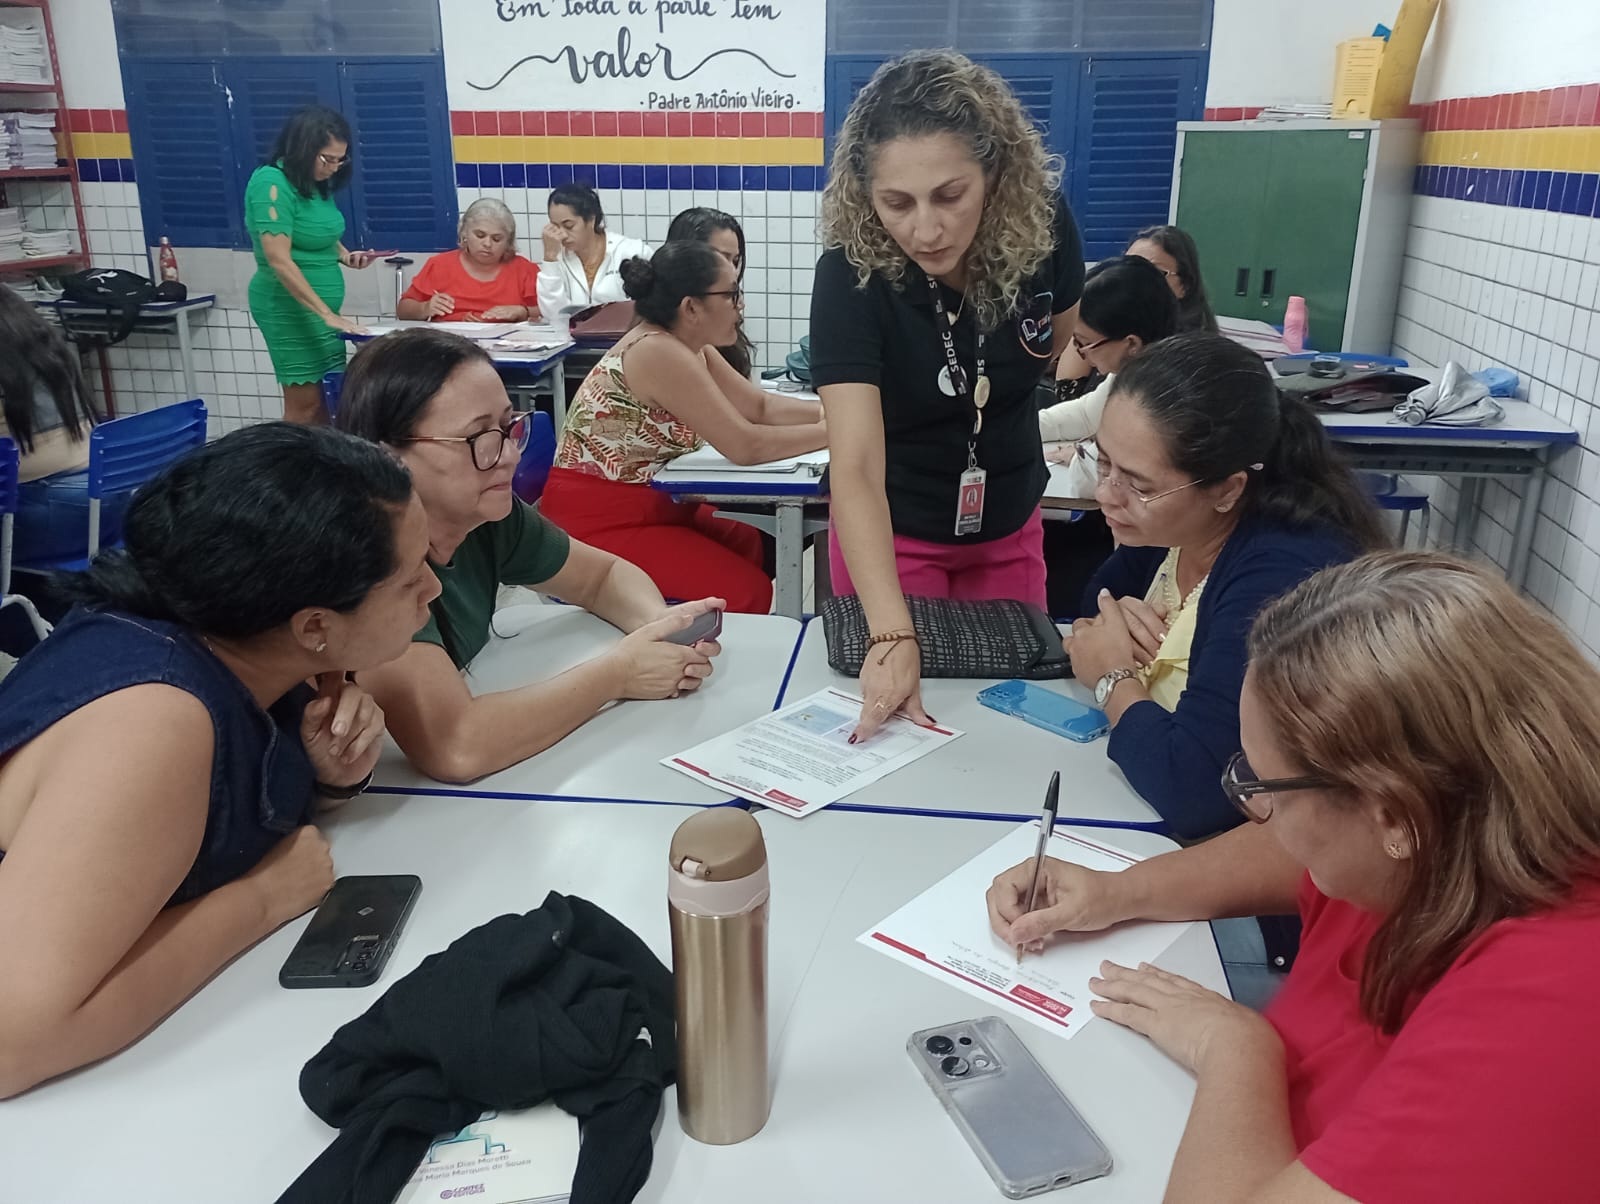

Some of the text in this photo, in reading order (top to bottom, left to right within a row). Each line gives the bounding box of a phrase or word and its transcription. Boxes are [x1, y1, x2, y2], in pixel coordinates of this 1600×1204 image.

[496, 0, 550, 21] Em
[628, 0, 647, 15] a
[655, 0, 717, 33] parte
[731, 0, 781, 20] tem
[696, 89, 747, 109] Antônio
[942, 330, 960, 373] SEDEC
